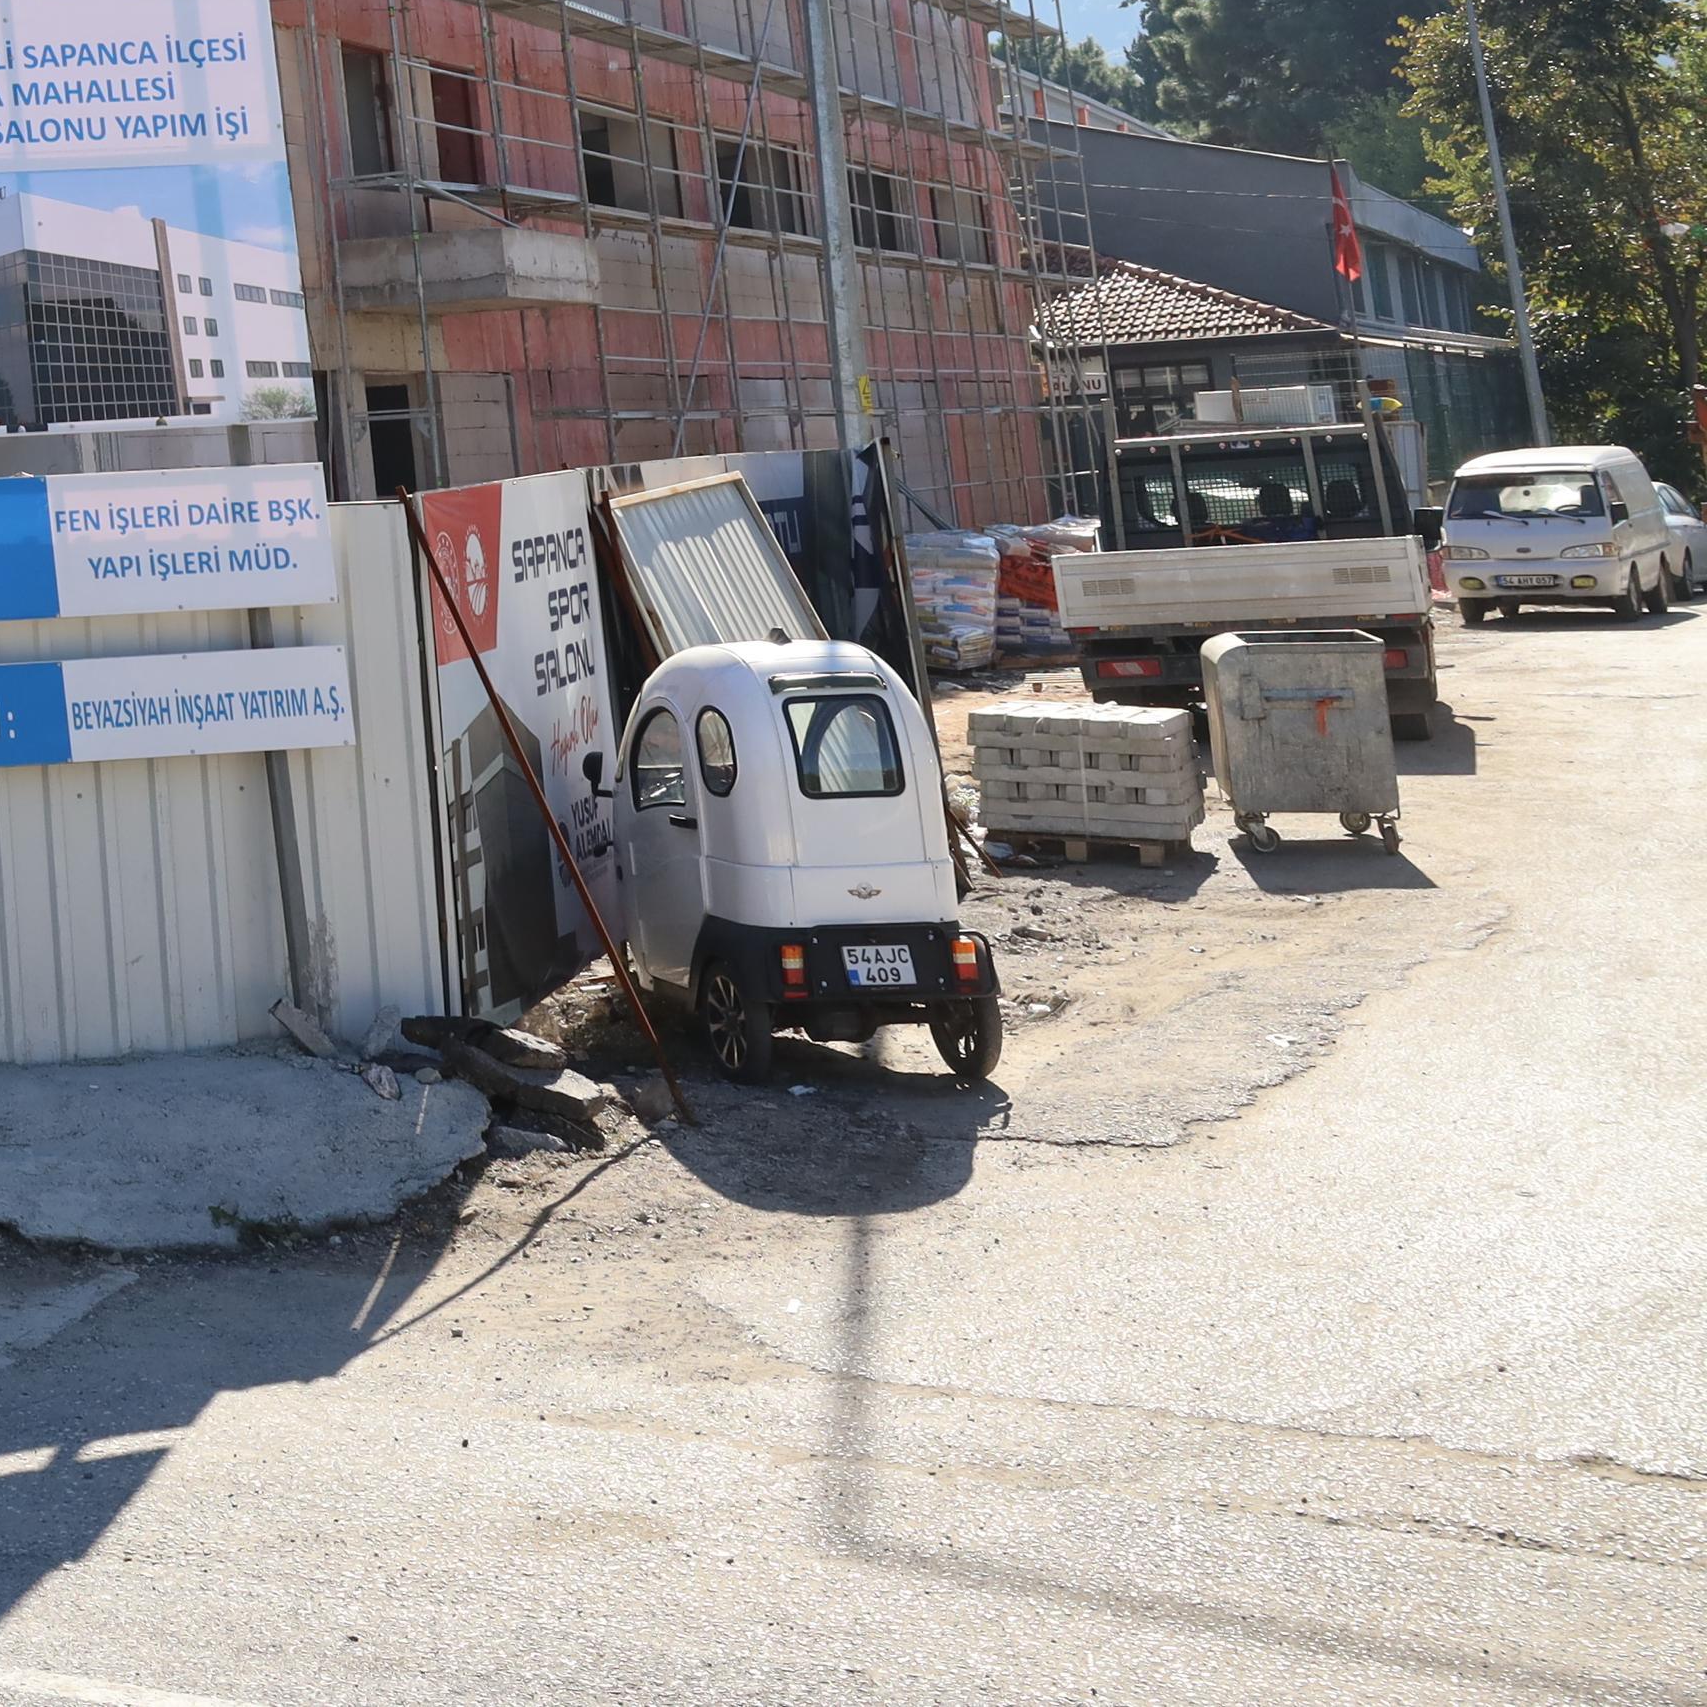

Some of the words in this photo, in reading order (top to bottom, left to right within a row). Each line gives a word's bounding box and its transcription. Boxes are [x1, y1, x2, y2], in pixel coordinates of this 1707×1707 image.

[24, 40, 159, 70] SAPANCA
[166, 30, 247, 69] İLÇESİ
[12, 69, 176, 107] MAHALLESİ
[115, 109, 208, 140] YAPIM
[215, 104, 249, 138] İŞİ
[55, 508, 102, 534] FEN
[108, 497, 180, 533] İŞLERİ
[187, 495, 261, 528] DAİRE
[268, 495, 321, 528] BŞK.
[88, 553, 142, 581] YAPI
[148, 546, 221, 582] İŞLERİ
[228, 542, 298, 573] MÜD.
[512, 527, 587, 584] SAPANCA
[548, 582, 591, 632] SPOR
[534, 638, 596, 697] SALONU
[71, 687, 172, 732] BEYAZSİYAH
[177, 686, 235, 728] İNŞAAT
[240, 687, 309, 721] YATIRIM
[312, 683, 346, 719] A.Ş.
[866, 966, 902, 983] 409
